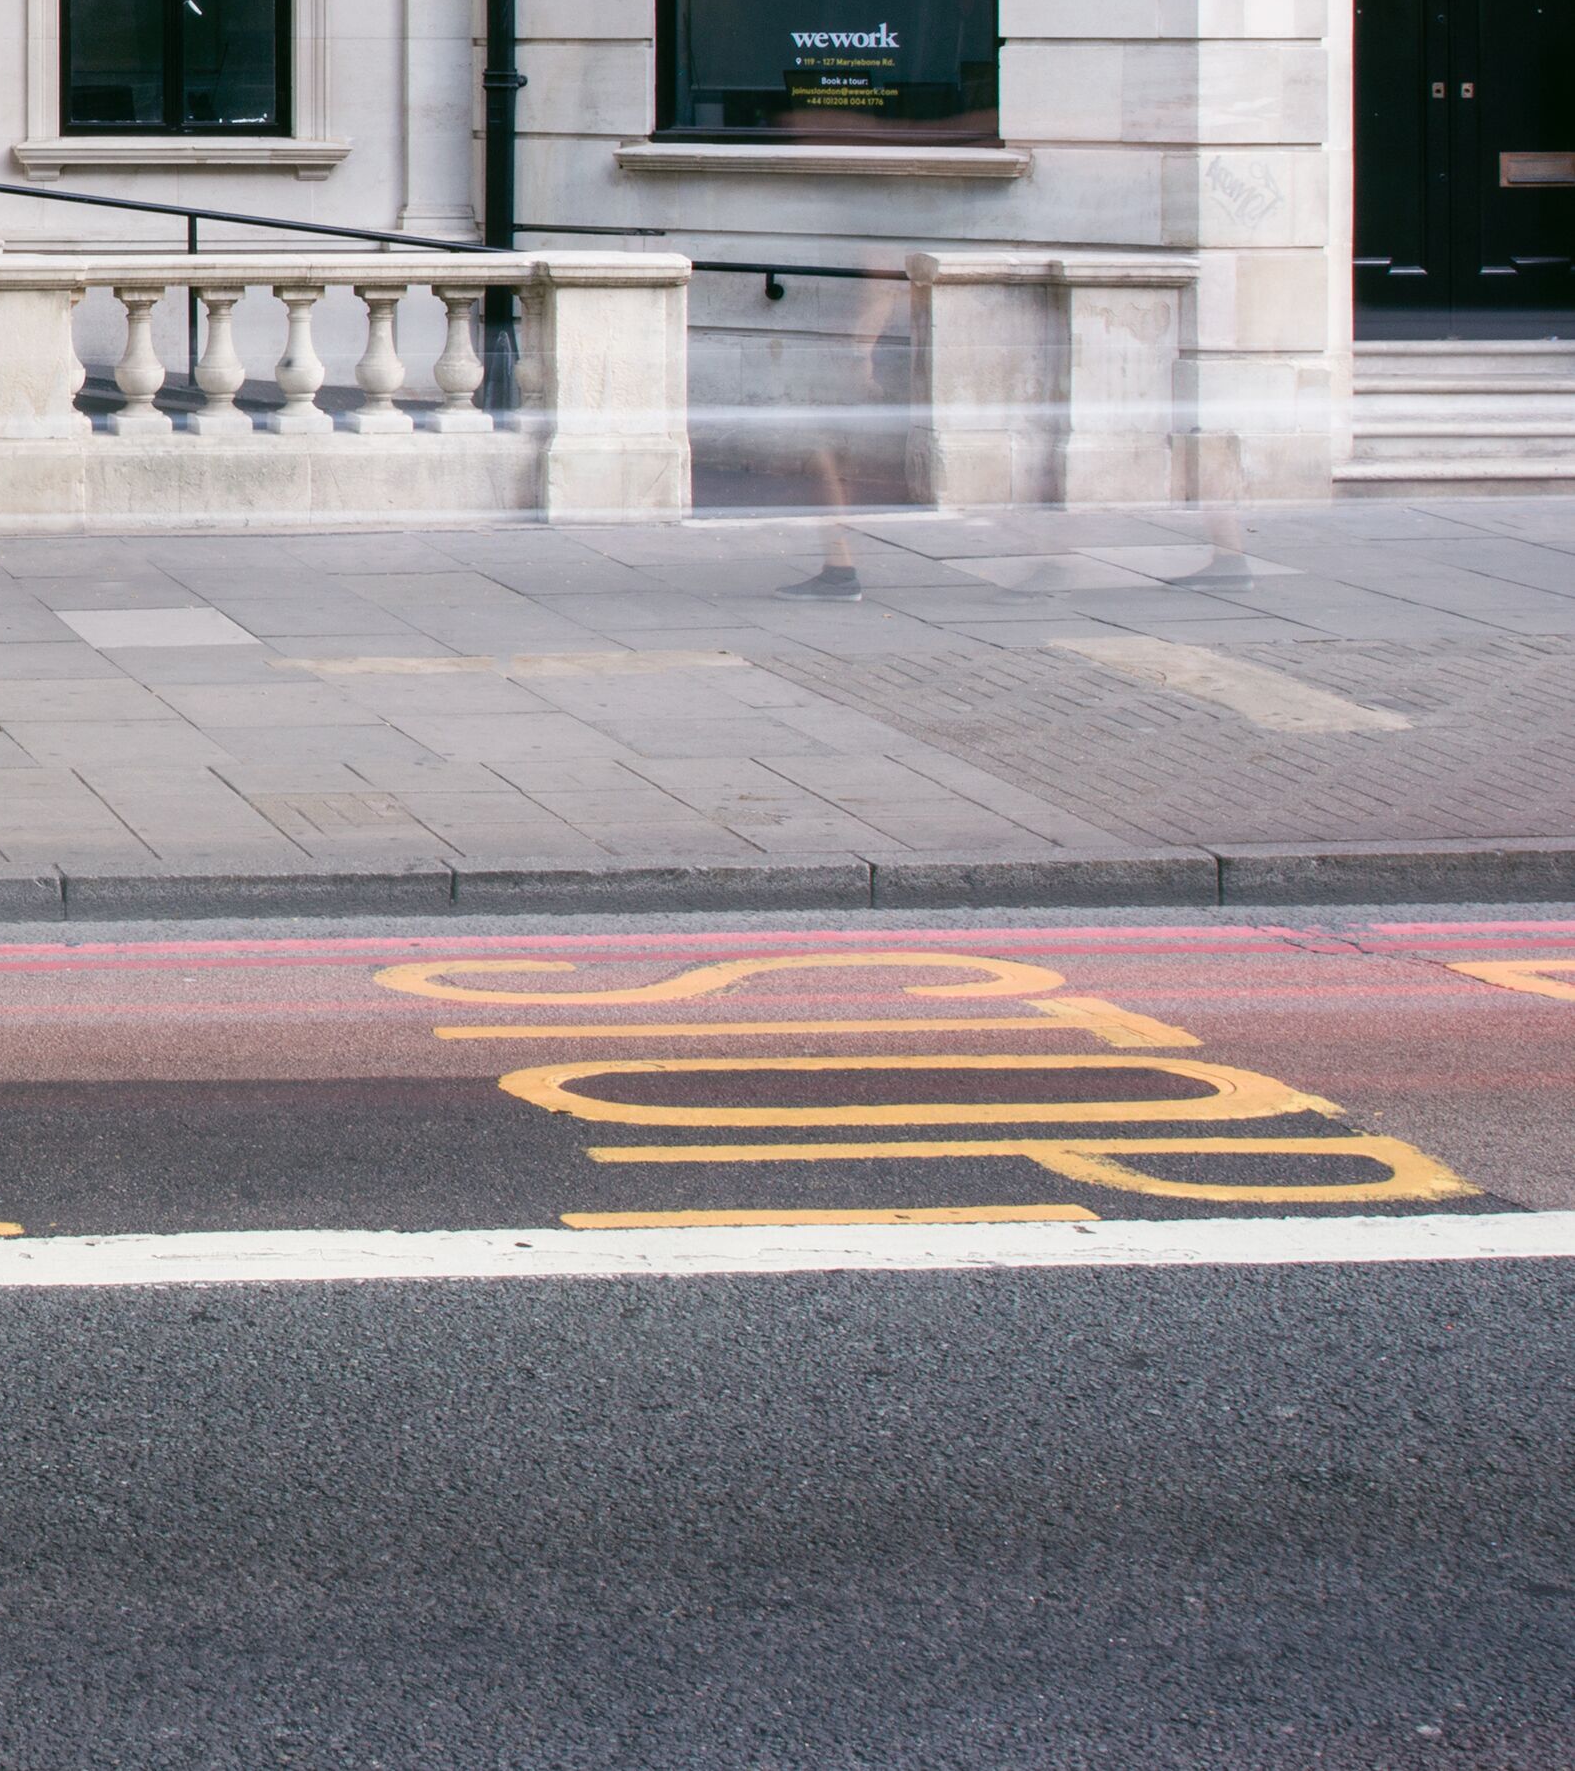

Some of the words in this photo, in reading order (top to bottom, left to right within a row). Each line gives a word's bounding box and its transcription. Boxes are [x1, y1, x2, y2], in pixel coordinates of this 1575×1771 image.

[790, 22, 900, 48] wework
[804, 58, 815, 66] 119
[822, 58, 835, 66] 127
[836, 58, 881, 67] Marylebone
[882, 58, 895, 66] Rd.
[821, 77, 841, 85] Book
[849, 77, 868, 85] tour:
[372, 951, 1485, 1204] STOP
